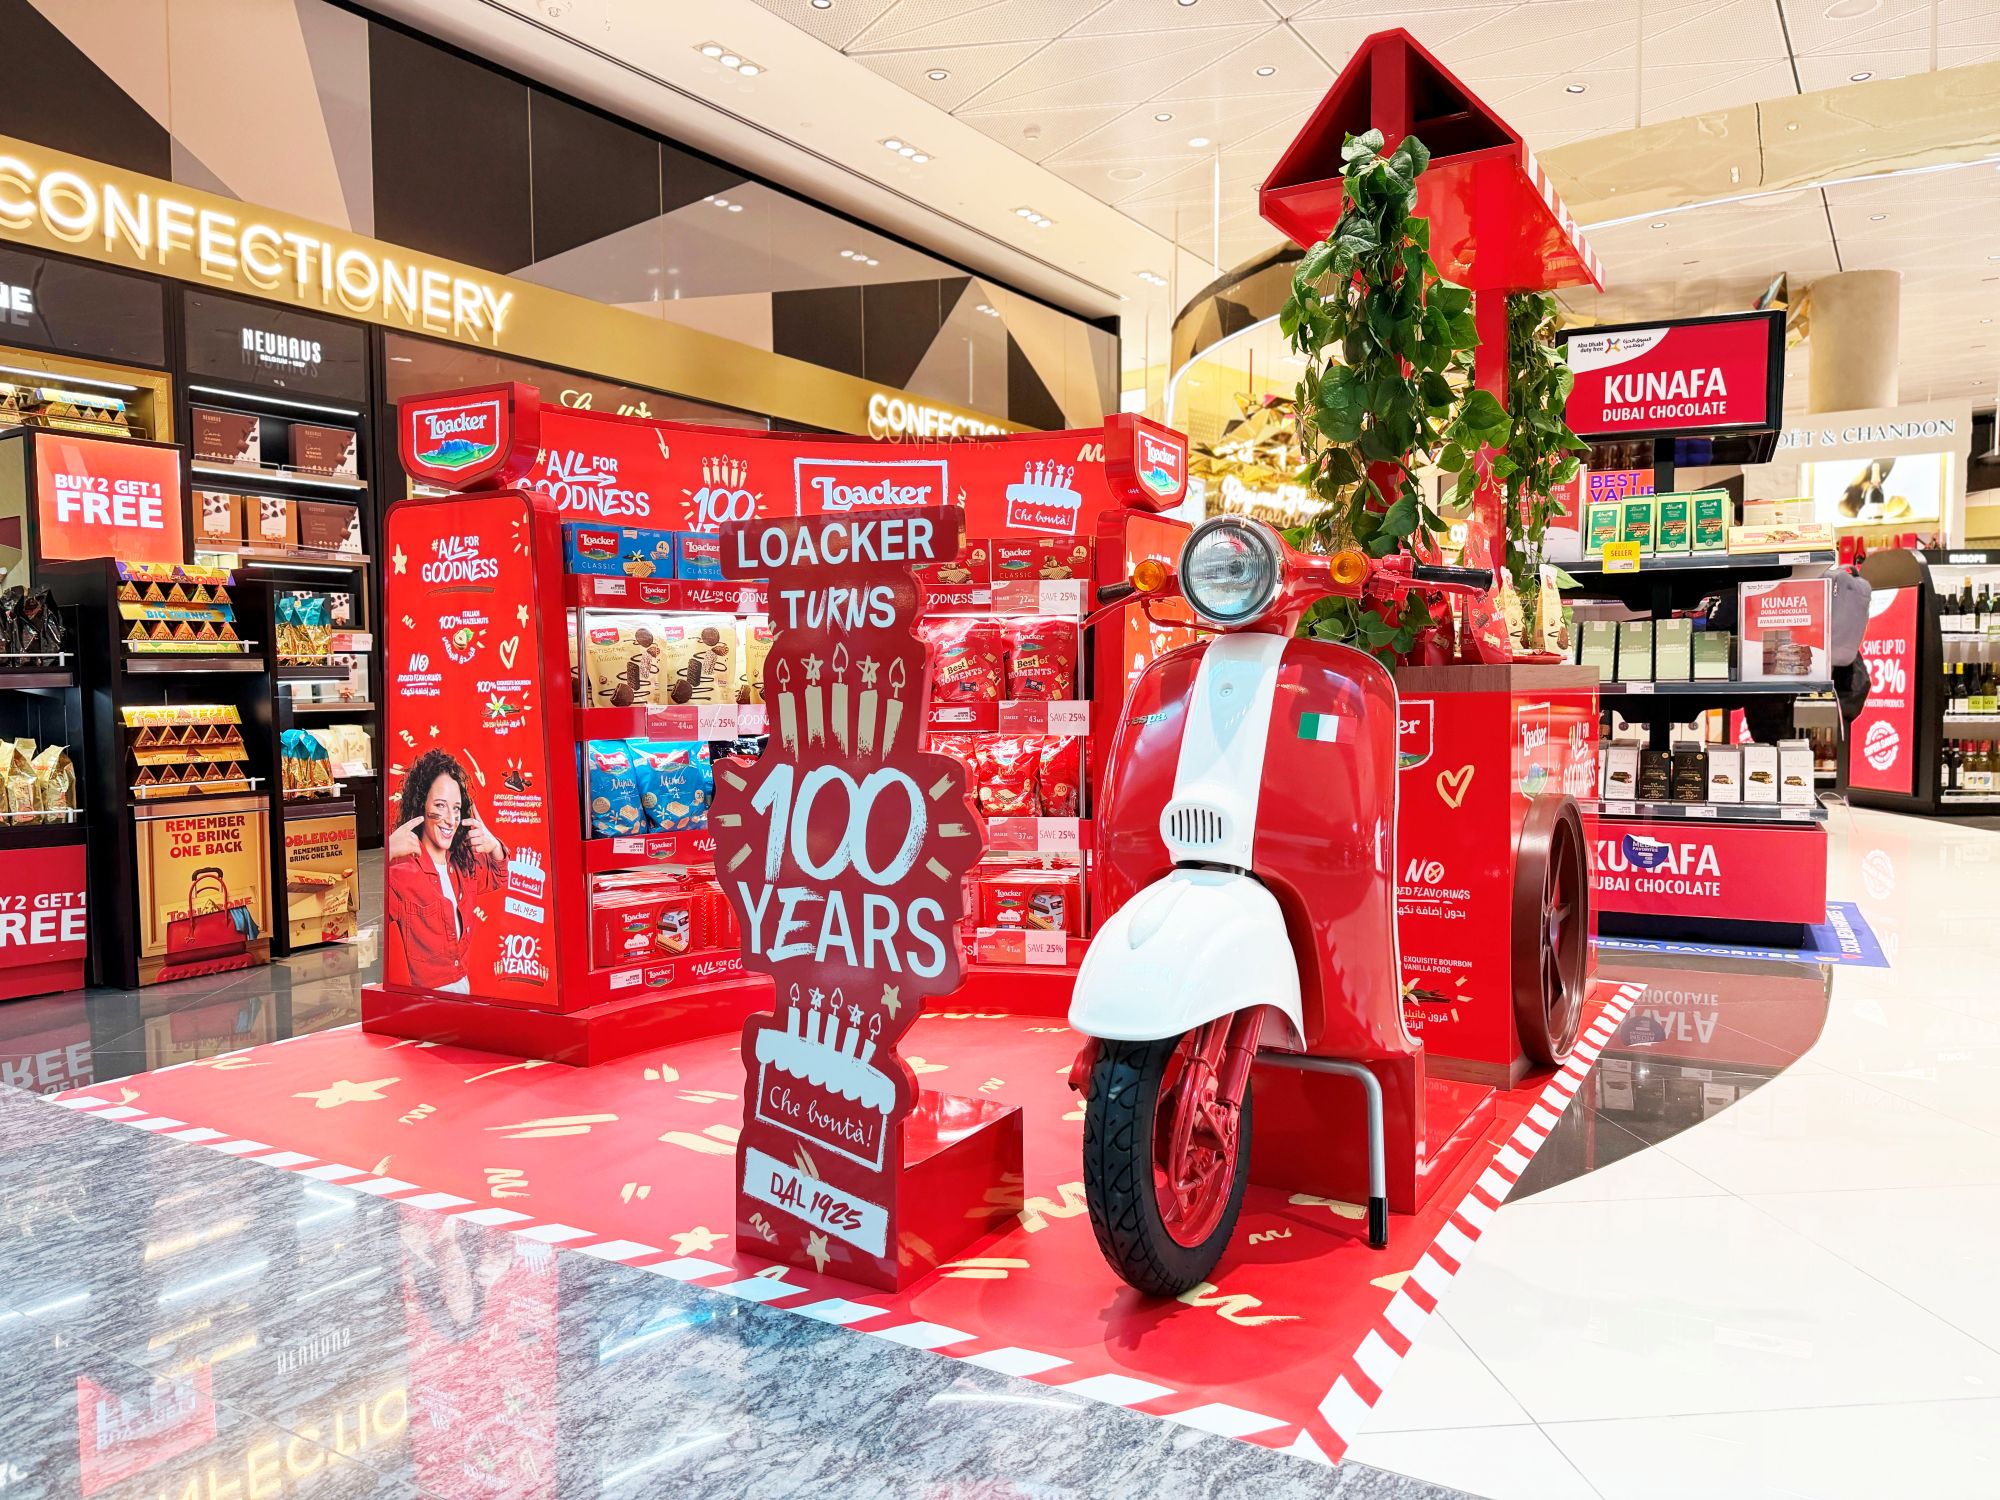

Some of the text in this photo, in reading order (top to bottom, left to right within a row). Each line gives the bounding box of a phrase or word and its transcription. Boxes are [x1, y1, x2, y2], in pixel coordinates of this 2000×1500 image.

[0, 155, 513, 334] CONFECTIONERY
[242, 328, 321, 363] NEUHAUS
[1604, 367, 1727, 404] KUNAFA
[1603, 401, 1727, 422] DUBAI CHOCOLATE
[425, 412, 487, 439] Loacker
[1777, 419, 1955, 448] OËT & CHANDON
[1145, 440, 1177, 467] Loacker
[592, 456, 618, 472] FOR
[55, 473, 161, 496] BUY 2 GET 1
[1591, 473, 1640, 488] BEST
[811, 476, 932, 512] Loacker
[56, 490, 165, 529] FREE
[693, 487, 755, 522] 100
[1014, 508, 1071, 526] Che bontà!
[431, 536, 479, 559] #ALL FOR
[580, 533, 615, 546] Loacker
[686, 541, 719, 552] Loacker
[737, 518, 935, 569] LOACKER
[998, 548, 1031, 559] Loacker
[1950, 554, 1986, 563] EUROPE
[422, 558, 498, 583] GOODNESS
[582, 561, 616, 570] CLASSIC
[643, 586, 666, 594] Loacker
[687, 588, 724, 602] #ALL FOR
[1041, 593, 1077, 601] SAVE 25%
[926, 594, 973, 605] OODNESS
[1761, 596, 1807, 608] KUNAFA
[145, 610, 214, 620] BIG THANKS
[780, 582, 896, 636] TURNS
[1016, 632, 1045, 642] Loacker
[1862, 639, 1905, 656] SAVE UP TO
[409, 653, 429, 672] NO
[947, 657, 978, 675] Best of
[1017, 656, 1049, 667] Best of
[1008, 669, 1052, 679] MOMENTS
[718, 719, 735, 727] 25%
[1049, 713, 1086, 722] SAVE 25%
[1521, 723, 1546, 757] Loacker
[1881, 733, 1899, 747] SAVER
[165, 815, 245, 832] REMEMBER
[750, 763, 928, 886] 100
[172, 829, 239, 845] TO BRING
[285, 829, 355, 847] OBLERONE
[1039, 831, 1075, 839] SAVE 25%
[170, 841, 243, 858] ONE BACK
[293, 846, 329, 855] REMEMBER
[649, 841, 673, 850] Loacker
[290, 853, 310, 862] BRING
[1597, 839, 1721, 876] KUAFA
[1405, 858, 1445, 884] NO
[995, 889, 1022, 898] Loacker
[1413, 887, 1470, 900] FLAVORINGS
[1598, 876, 1721, 897] UBAI CHOCOLATE
[15, 895, 26, 910] 2
[34, 892, 74, 908] GET
[77, 891, 86, 906] 1
[622, 912, 650, 922] Loacker
[1444, 907, 1466, 919] بدون
[0, 908, 87, 948] REE
[736, 881, 946, 979] YEARS
[505, 934, 535, 959] 100
[1027, 944, 1063, 953] SAVE 25%
[1665, 945, 1800, 959] FAVORITES
[502, 957, 539, 976] YEARS
[1403, 955, 1472, 968] EXQUISITE BOURBON
[1403, 963, 1451, 974] VANILLA PODS
[647, 968, 671, 979] Loacker
[769, 1085, 874, 1148] Che bontà!
[770, 1171, 864, 1231] DAL 1925
